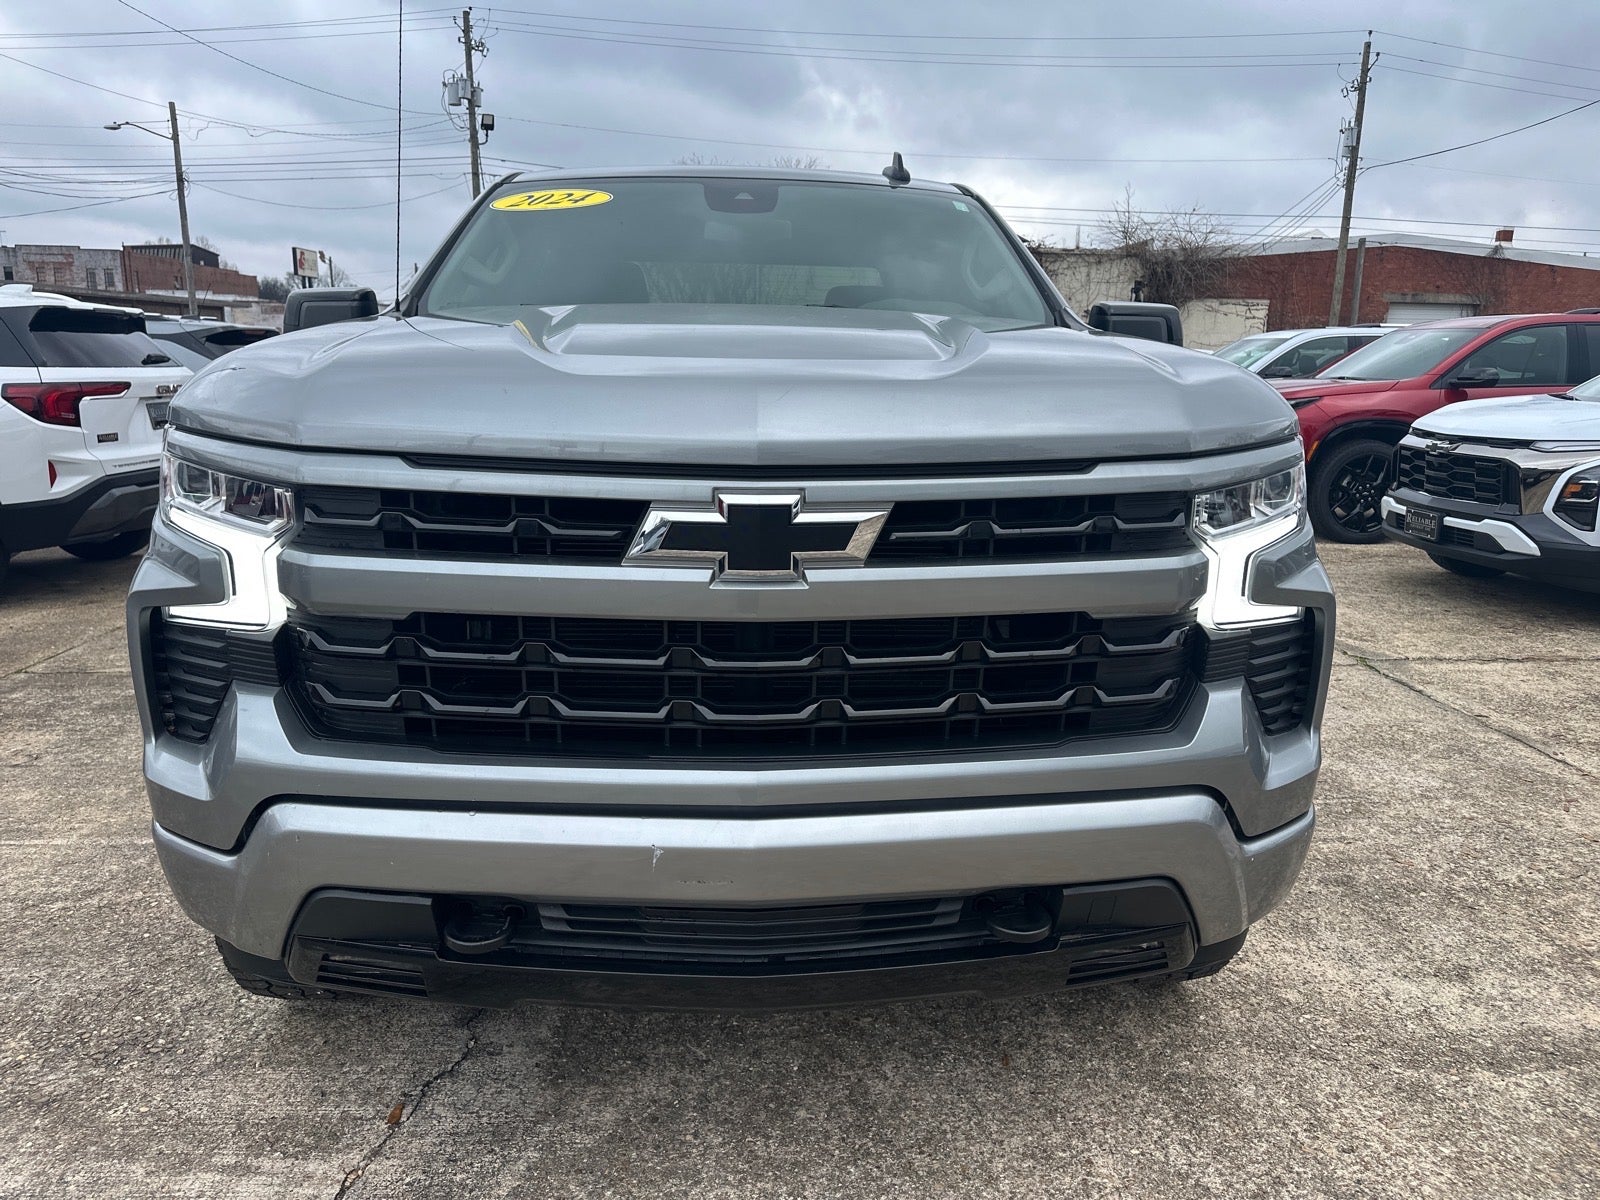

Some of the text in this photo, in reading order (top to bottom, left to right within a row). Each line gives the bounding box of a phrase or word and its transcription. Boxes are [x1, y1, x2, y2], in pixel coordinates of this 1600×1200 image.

[505, 192, 597, 208] 2024
[156, 384, 183, 395] GM
[1406, 512, 1436, 529] RELIABLE
